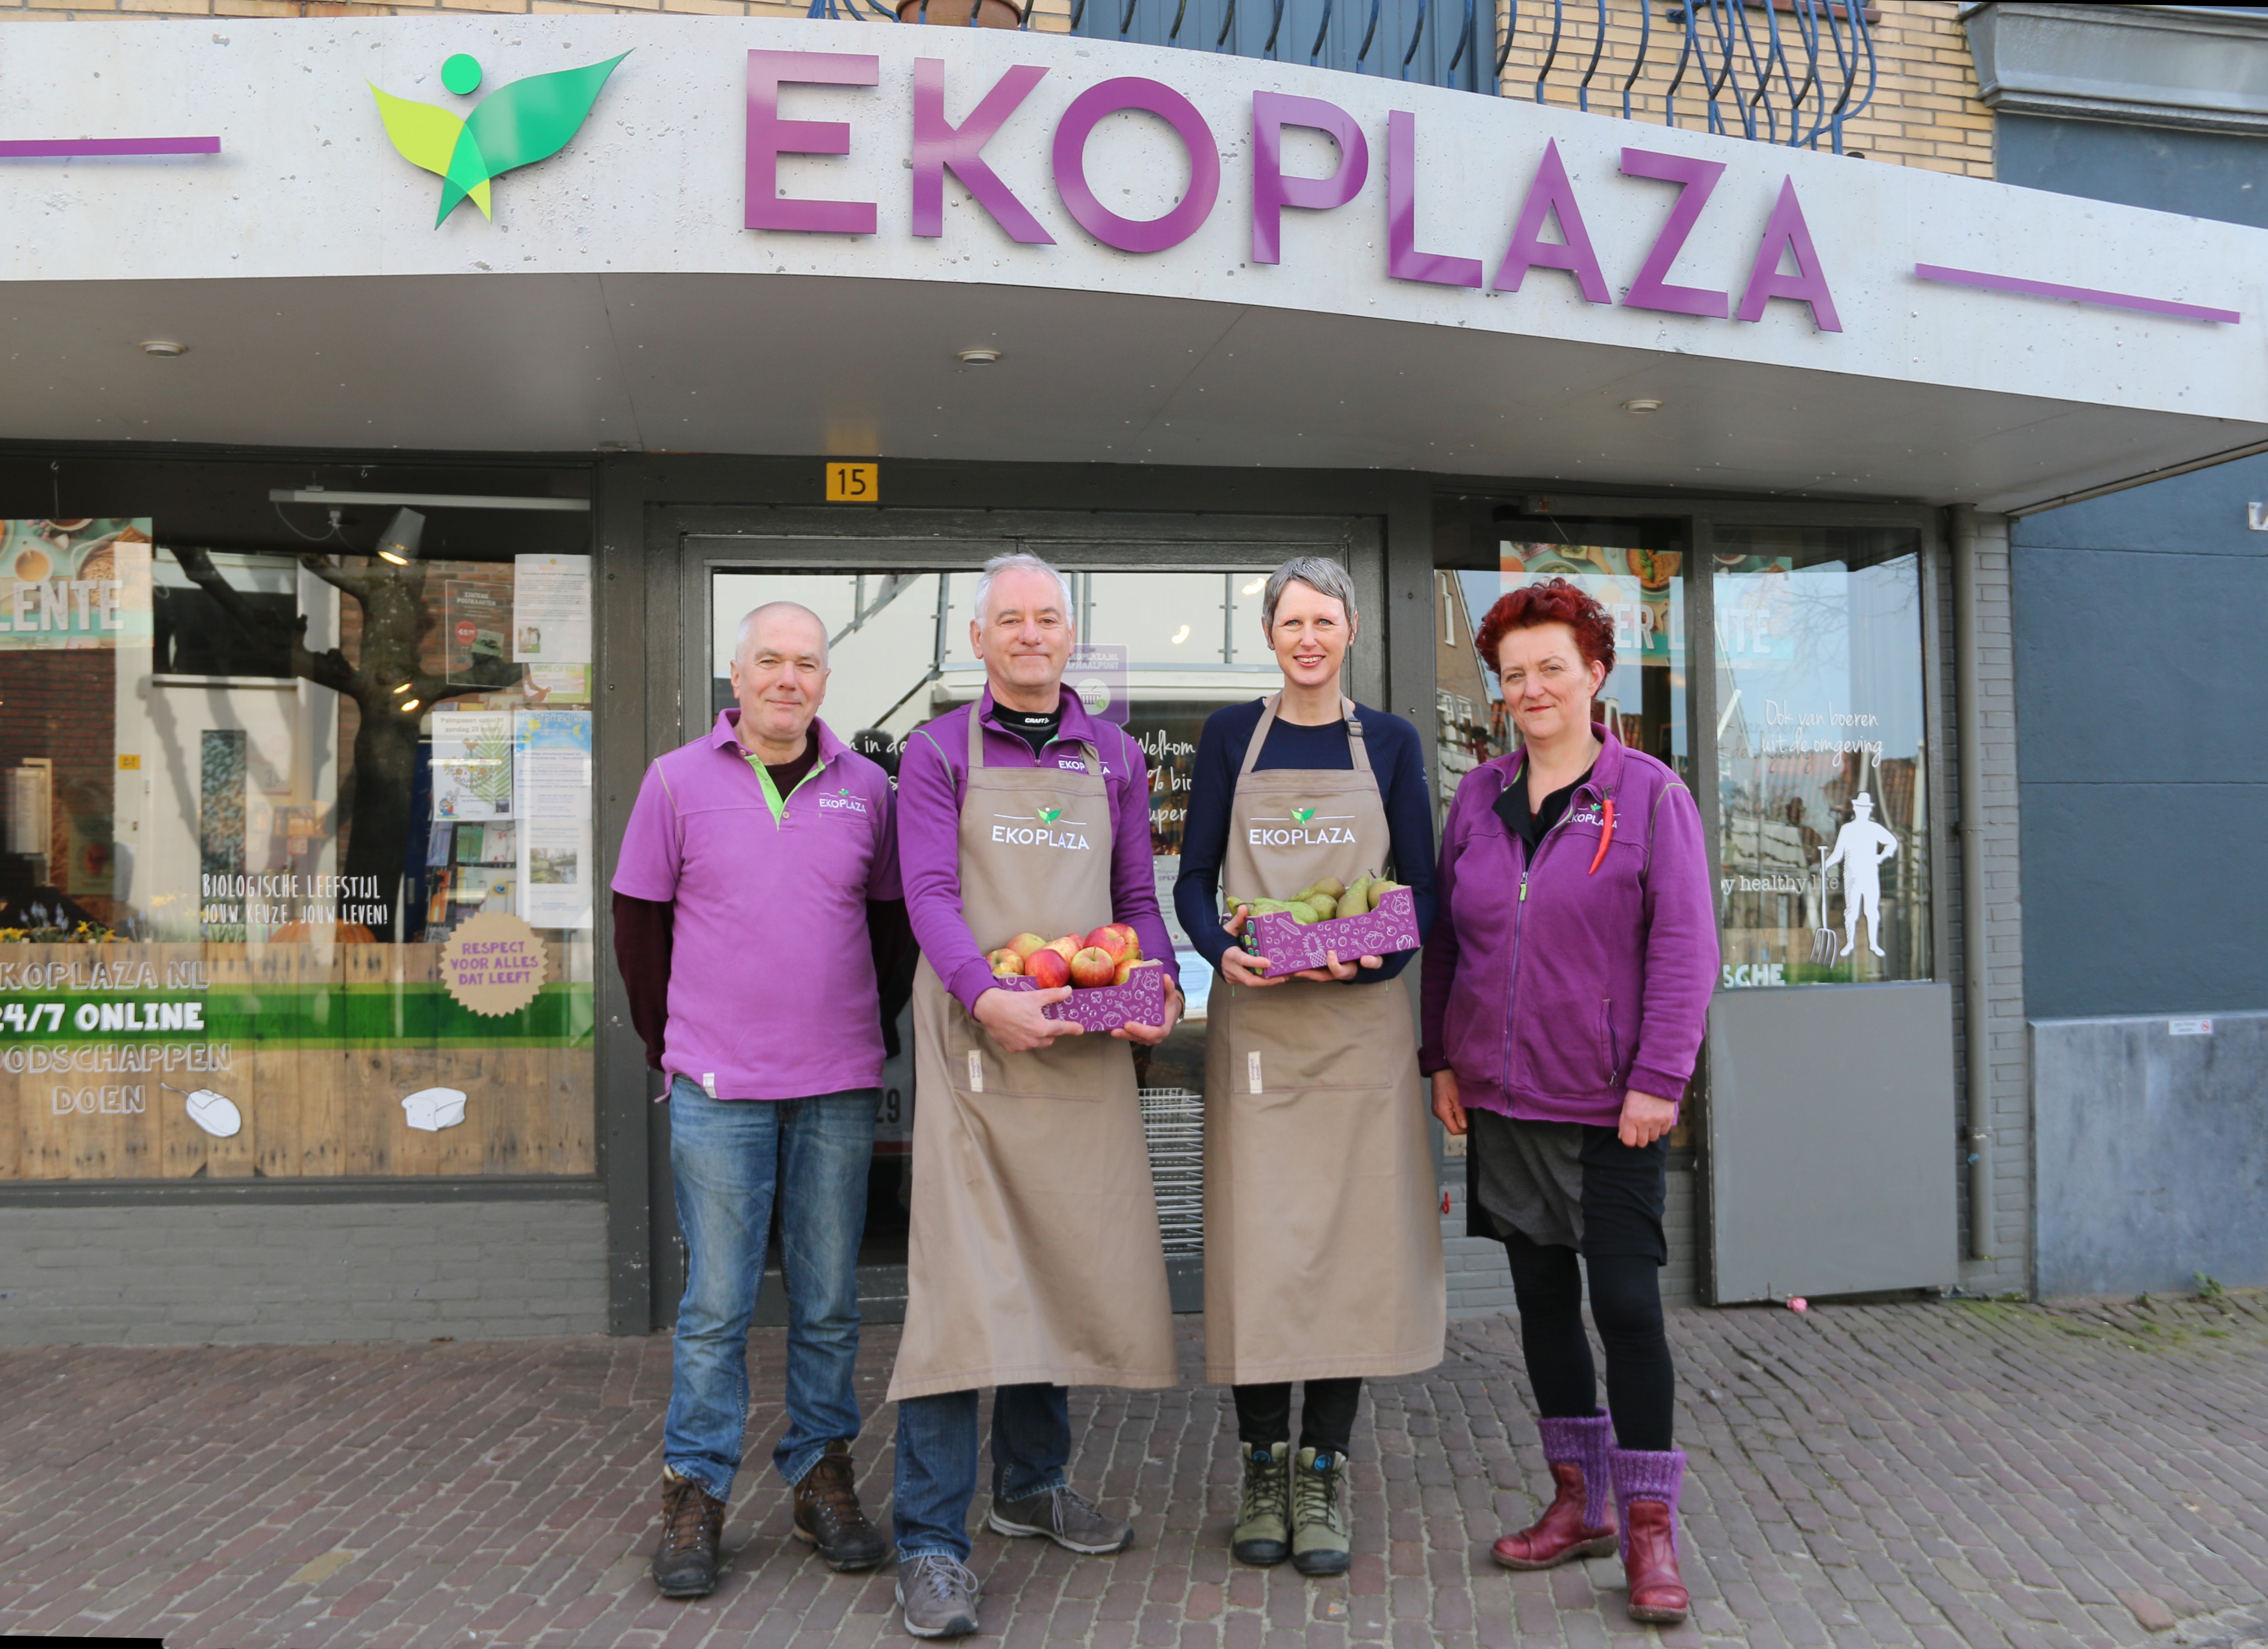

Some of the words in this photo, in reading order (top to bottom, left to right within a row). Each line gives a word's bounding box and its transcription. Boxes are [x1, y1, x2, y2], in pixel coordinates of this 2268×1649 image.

[744, 49, 1842, 332] EKOPLAZA
[838, 469, 866, 496] 15
[1765, 700, 1794, 725] Ook
[1799, 713, 1825, 726] van
[1829, 701, 1879, 726] boeren
[864, 736, 881, 753] in
[886, 729, 908, 756] de
[1132, 729, 1196, 760] Welkom
[1762, 735, 1787, 753] uit
[1789, 727, 1809, 754] de
[1814, 735, 1884, 767] omgeving
[819, 798, 867, 813] EKOPLAZA
[992, 825, 1089, 850] EKOPLAZA
[1249, 828, 1356, 846] EKOPLAZA
[202, 873, 299, 898] BIOLOGISCHE
[307, 874, 381, 899] LEEFSTIJL
[1739, 874, 1807, 894] healthy
[202, 903, 239, 923] JOUW
[246, 903, 293, 926] KEUZE,
[300, 904, 335, 924] JOUW
[343, 904, 388, 925] LEVEN!
[462, 940, 525, 955] RESPECT
[450, 957, 489, 970] VOOR
[494, 955, 539, 969] ALLES
[458, 972, 484, 986] DAT
[488, 970, 530, 984] LEEFT
[74, 1002, 205, 1032] ONLINE
[0, 1043, 232, 1074] ODSCHAPPEN
[52, 1084, 146, 1116] DOEN
